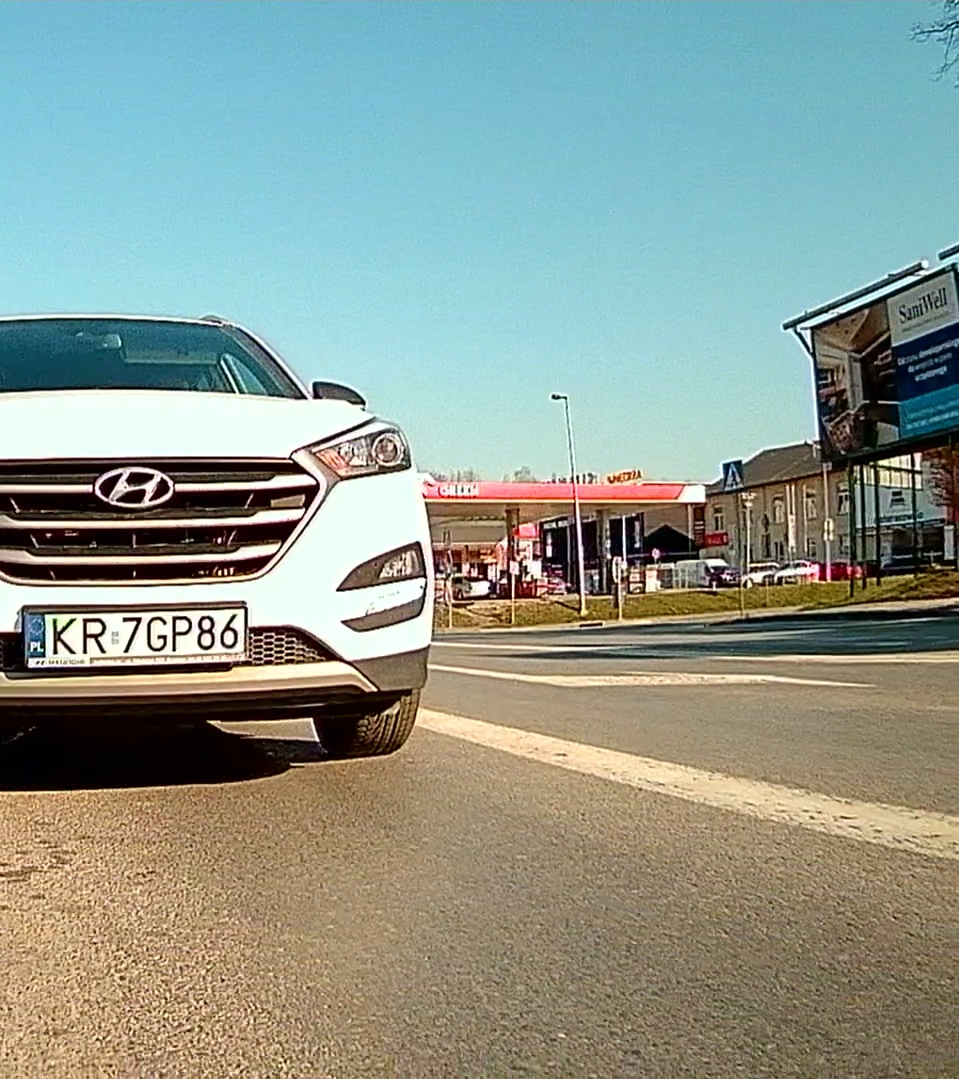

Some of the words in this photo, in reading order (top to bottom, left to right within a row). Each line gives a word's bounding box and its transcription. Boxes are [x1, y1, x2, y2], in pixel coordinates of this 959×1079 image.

[898, 287, 949, 324] SaniWell
[51, 617, 107, 655] KR
[122, 613, 239, 654] 7GP86
